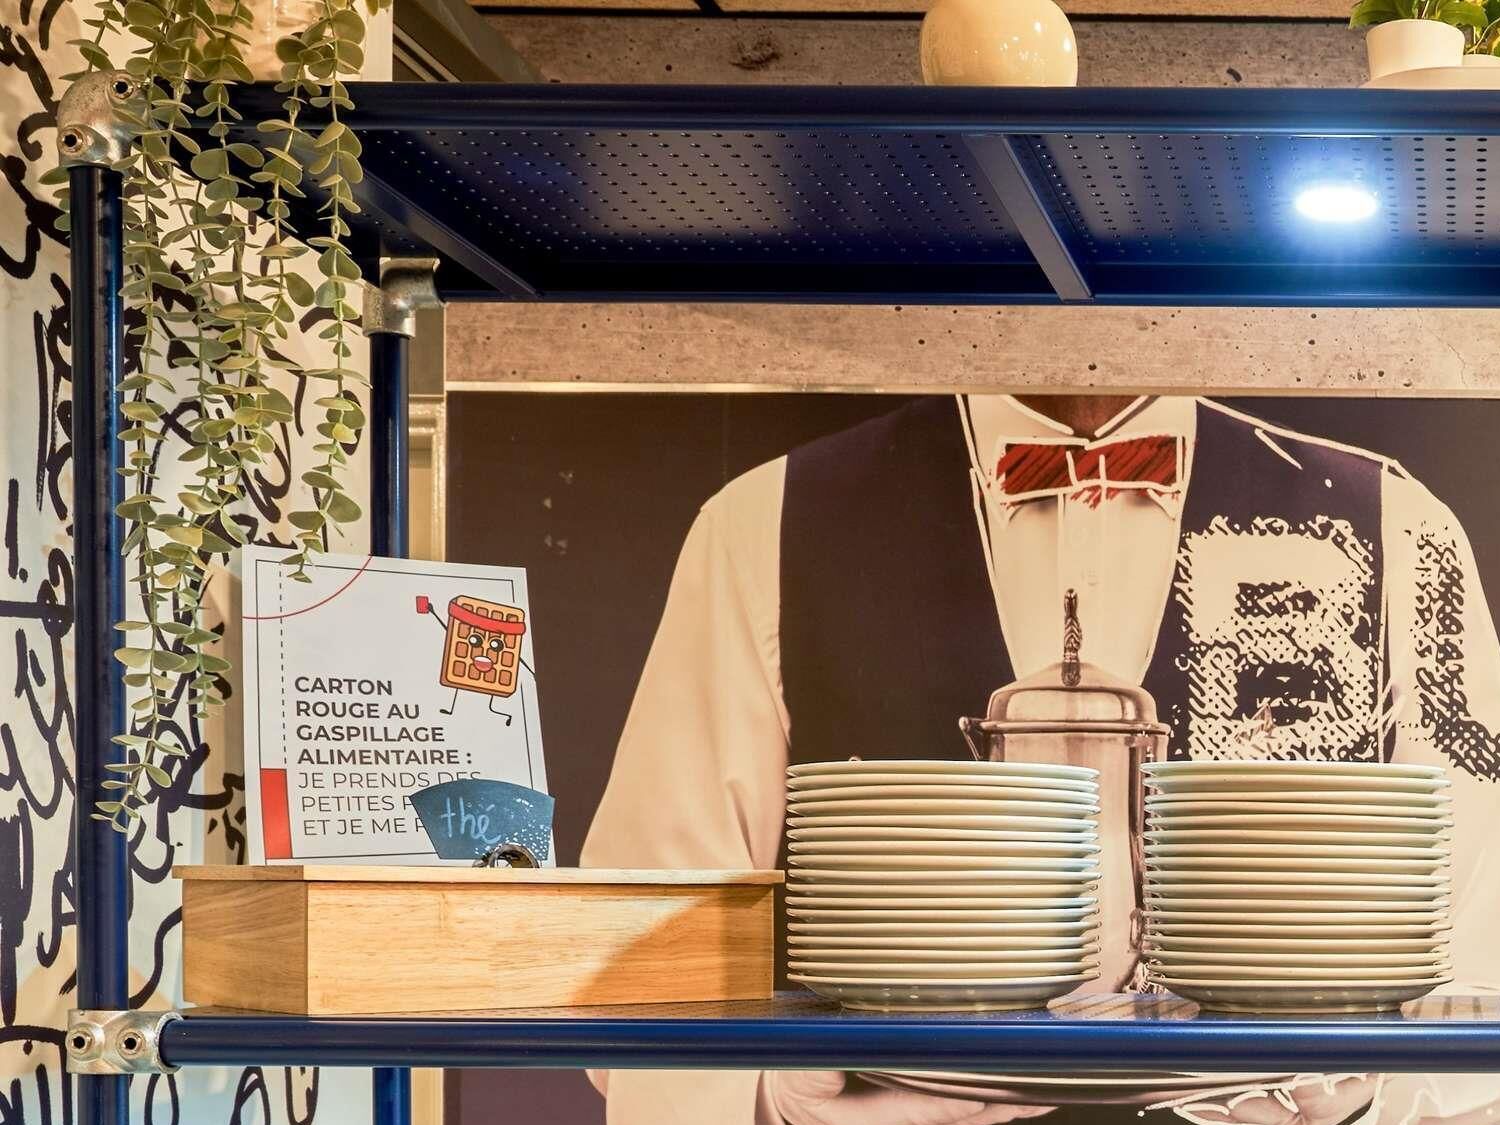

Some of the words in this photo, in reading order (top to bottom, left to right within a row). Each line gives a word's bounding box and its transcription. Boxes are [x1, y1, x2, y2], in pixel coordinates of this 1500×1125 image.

[294, 676, 393, 696] CARTON
[296, 700, 380, 719] ROUGE
[387, 703, 420, 720] AU
[296, 724, 445, 742] GASPILLAGE
[297, 748, 460, 765] ALIMENTAIRE
[298, 772, 325, 789] JE
[333, 771, 431, 789] PRENDS
[302, 795, 395, 812] PETITES
[303, 819, 330, 836] ET
[337, 818, 364, 836] JE
[372, 817, 407, 834] ME
